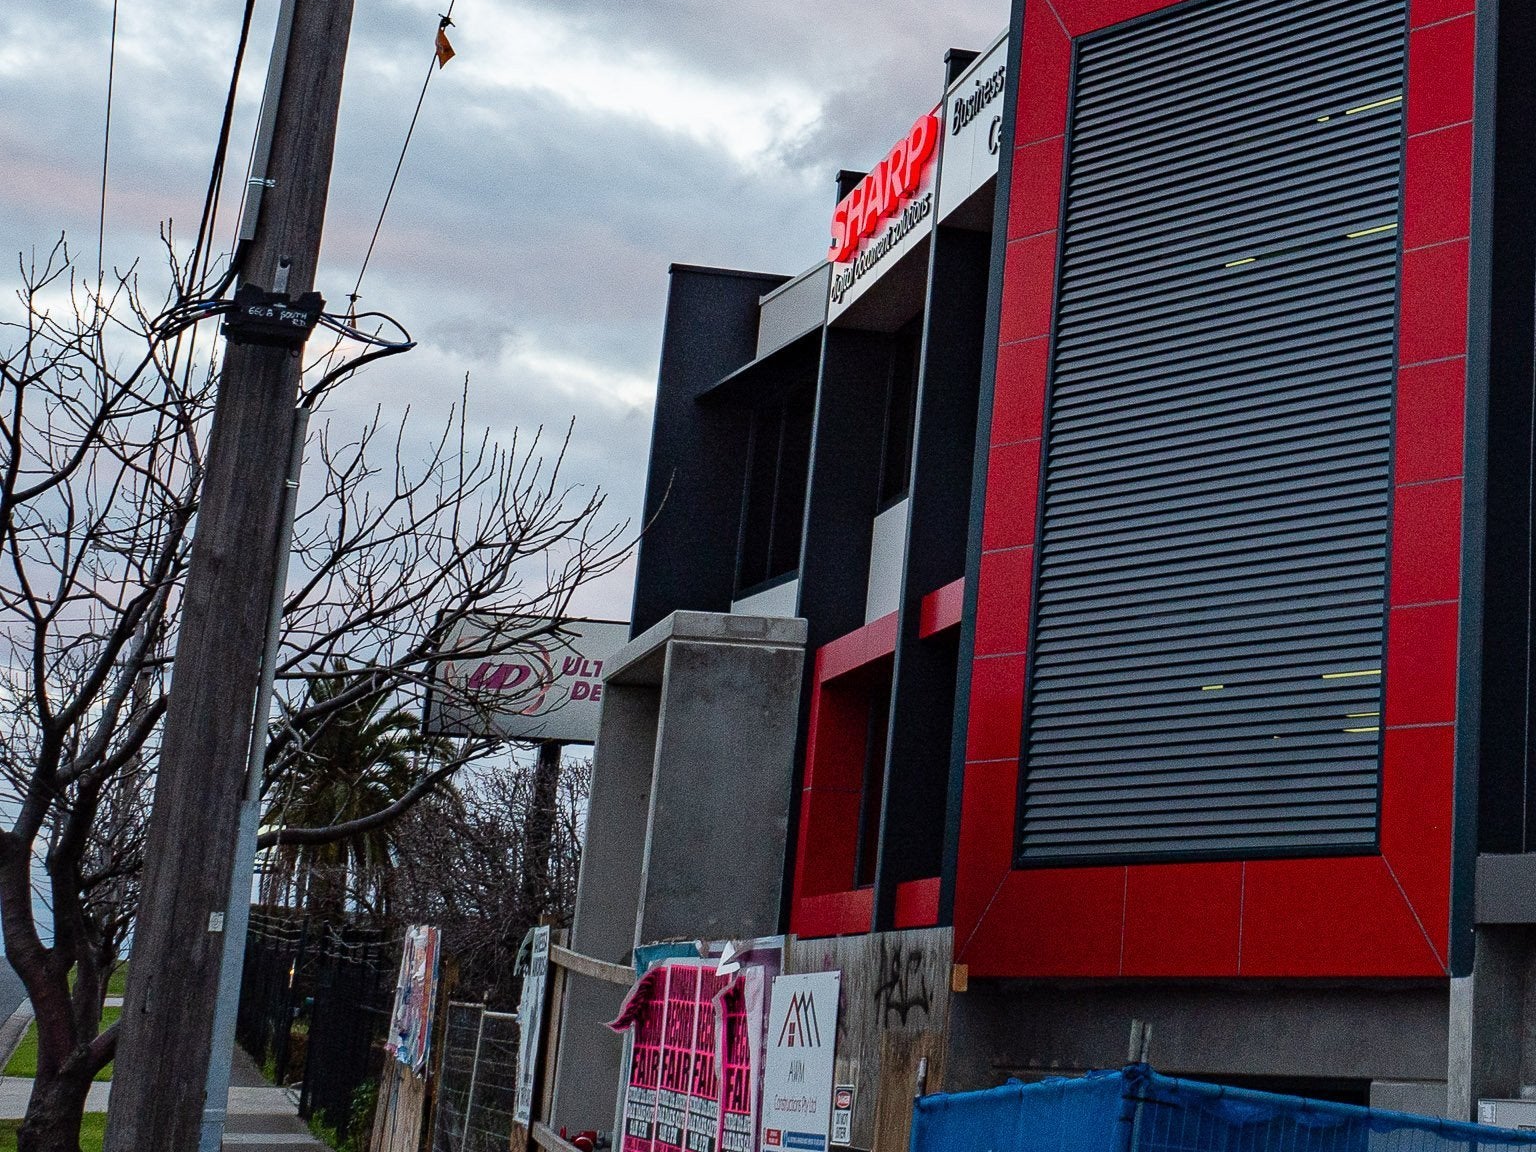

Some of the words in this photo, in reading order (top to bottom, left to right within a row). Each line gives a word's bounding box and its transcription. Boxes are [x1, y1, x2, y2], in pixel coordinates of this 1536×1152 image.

[952, 65, 1006, 136] Business
[827, 114, 938, 263] SHARP
[630, 1047, 660, 1089] FAIR
[660, 1049, 691, 1093] FAIR
